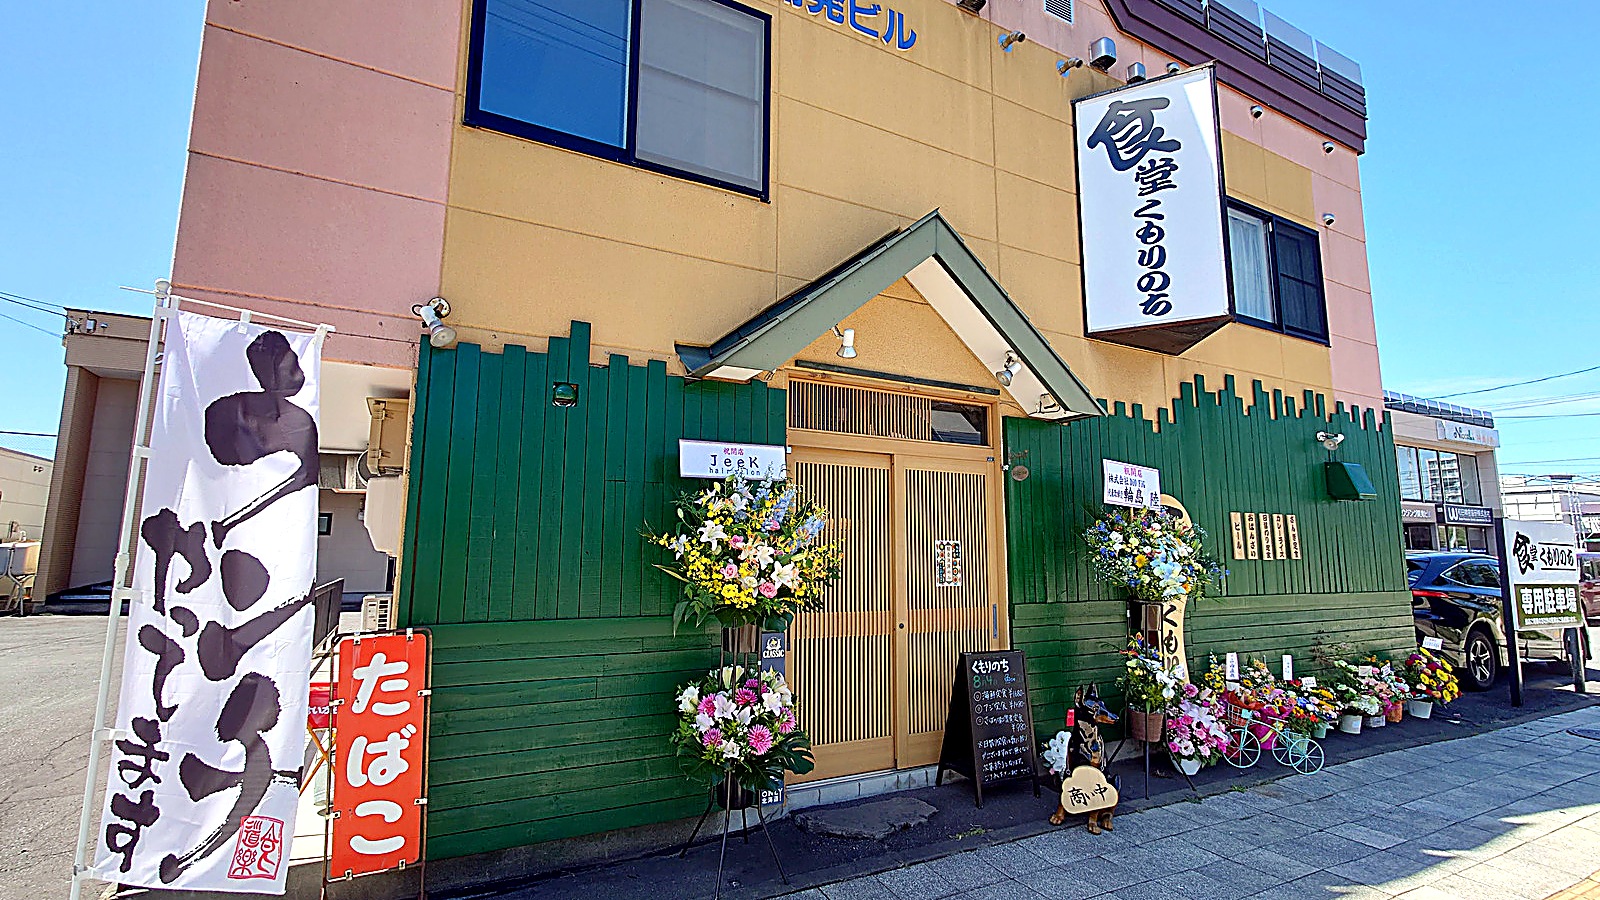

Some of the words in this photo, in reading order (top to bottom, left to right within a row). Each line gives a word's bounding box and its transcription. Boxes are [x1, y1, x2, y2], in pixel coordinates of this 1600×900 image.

[1520, 587, 1577, 614] 専用駐車場
[762, 649, 785, 659] CLASSIC
[971, 658, 1010, 674] くもりのち
[105, 508, 213, 873] やってます
[347, 653, 417, 855] たばこ
[1068, 783, 1108, 807] 商い中
